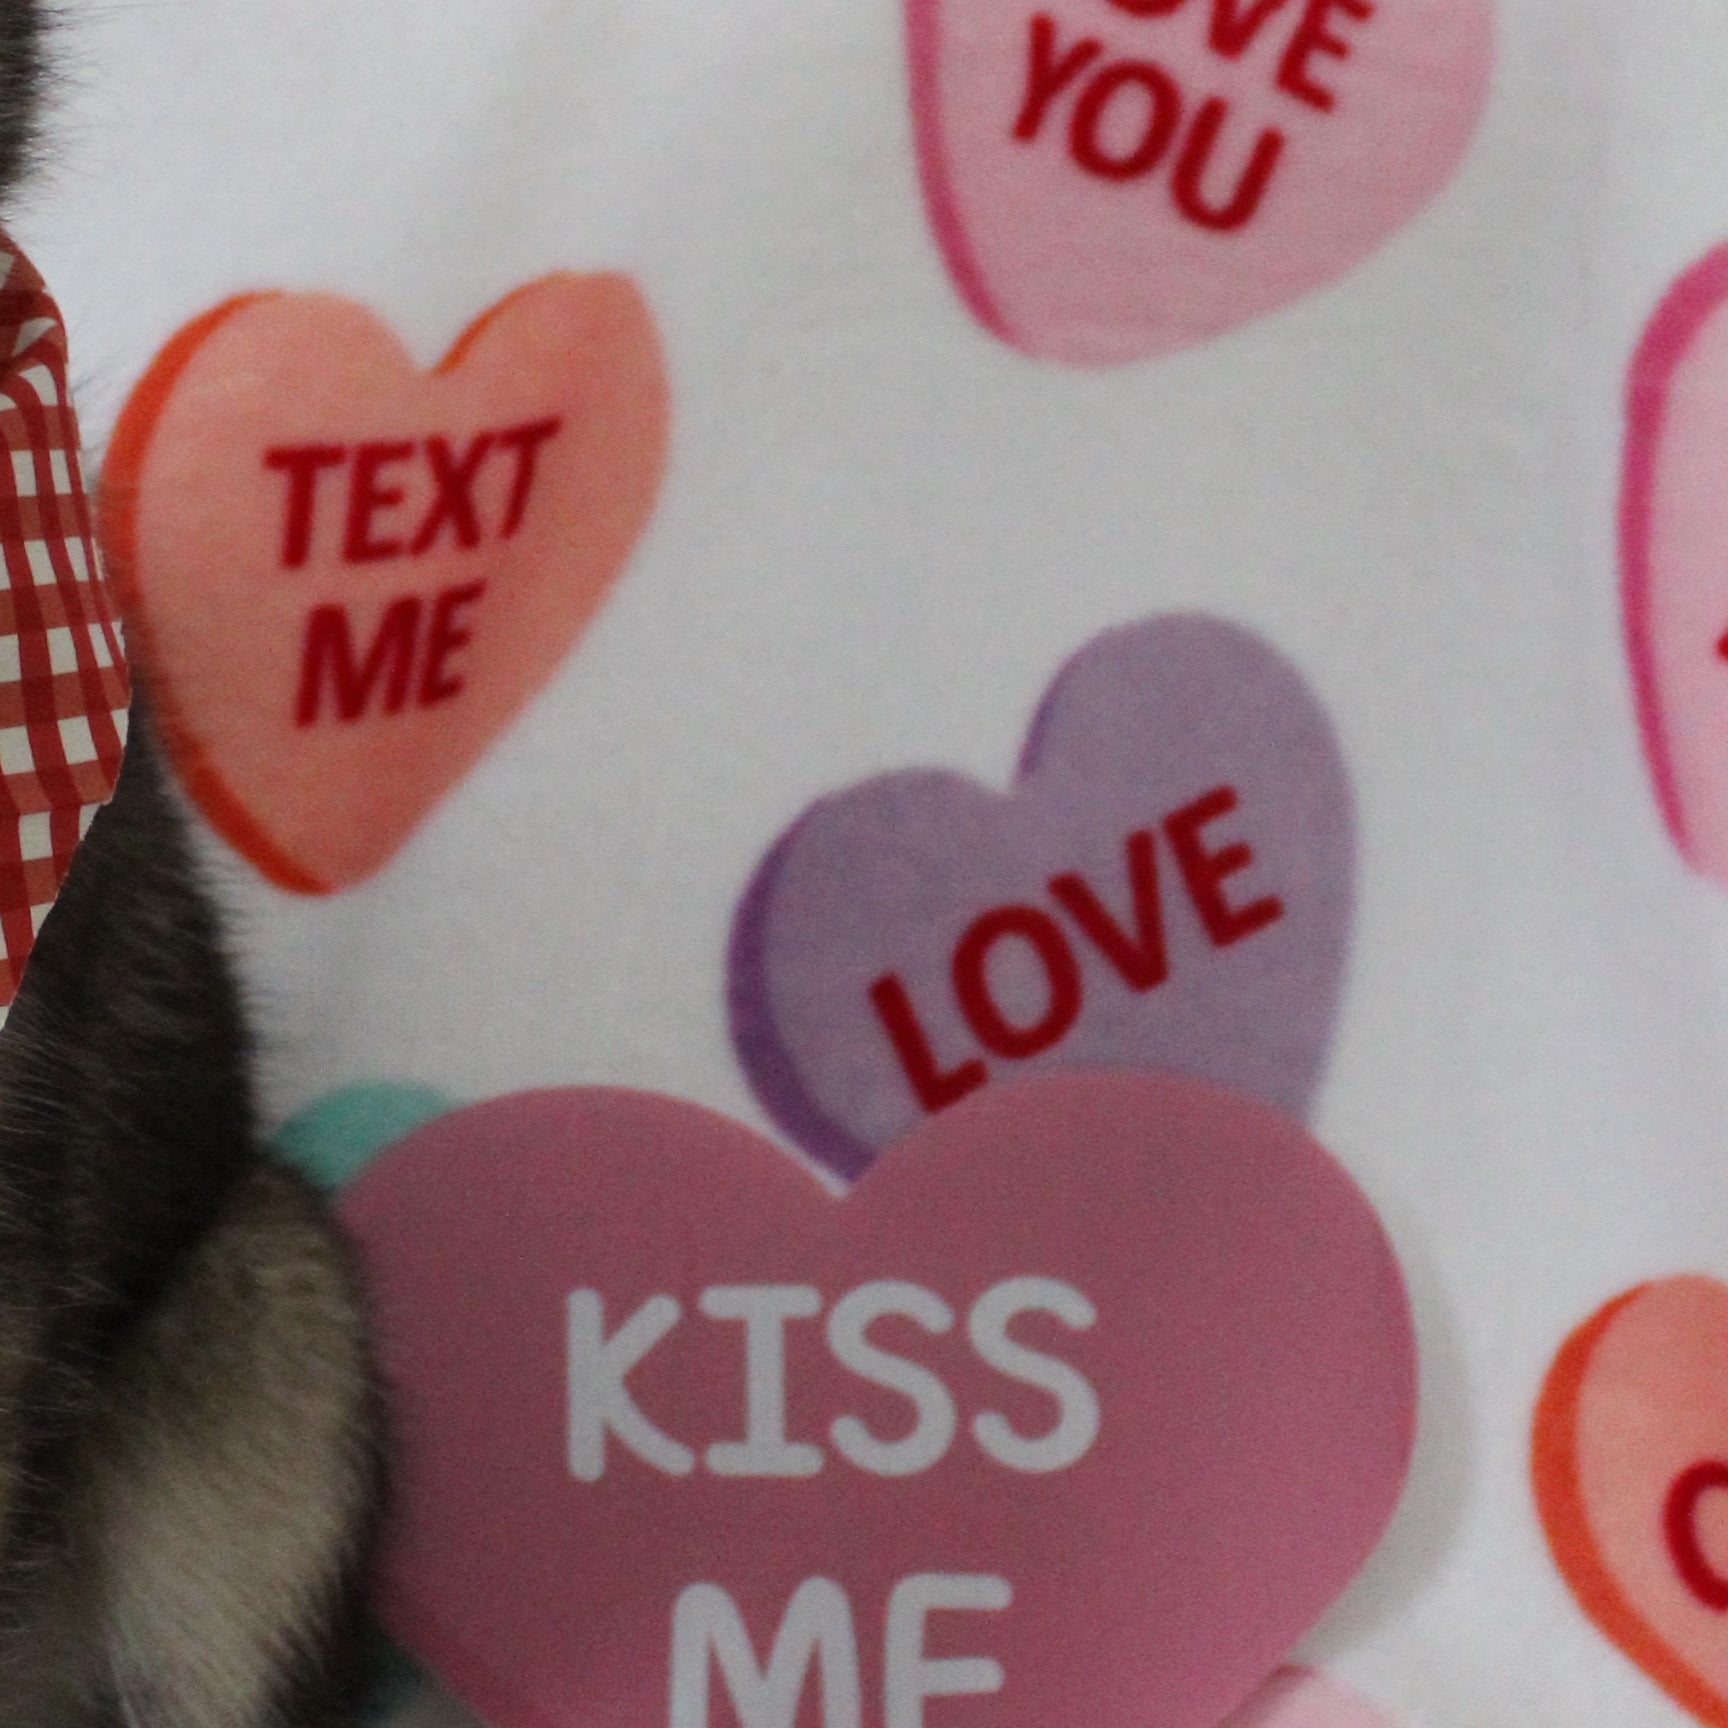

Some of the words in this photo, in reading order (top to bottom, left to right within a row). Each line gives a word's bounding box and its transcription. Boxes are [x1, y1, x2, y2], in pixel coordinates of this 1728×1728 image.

[1009, 14, 1285, 234] YOU
[262, 415, 562, 570] TEXT
[292, 580, 488, 729] ME
[866, 784, 1286, 1114] LOVE
[565, 1275, 1100, 1483] KISS
